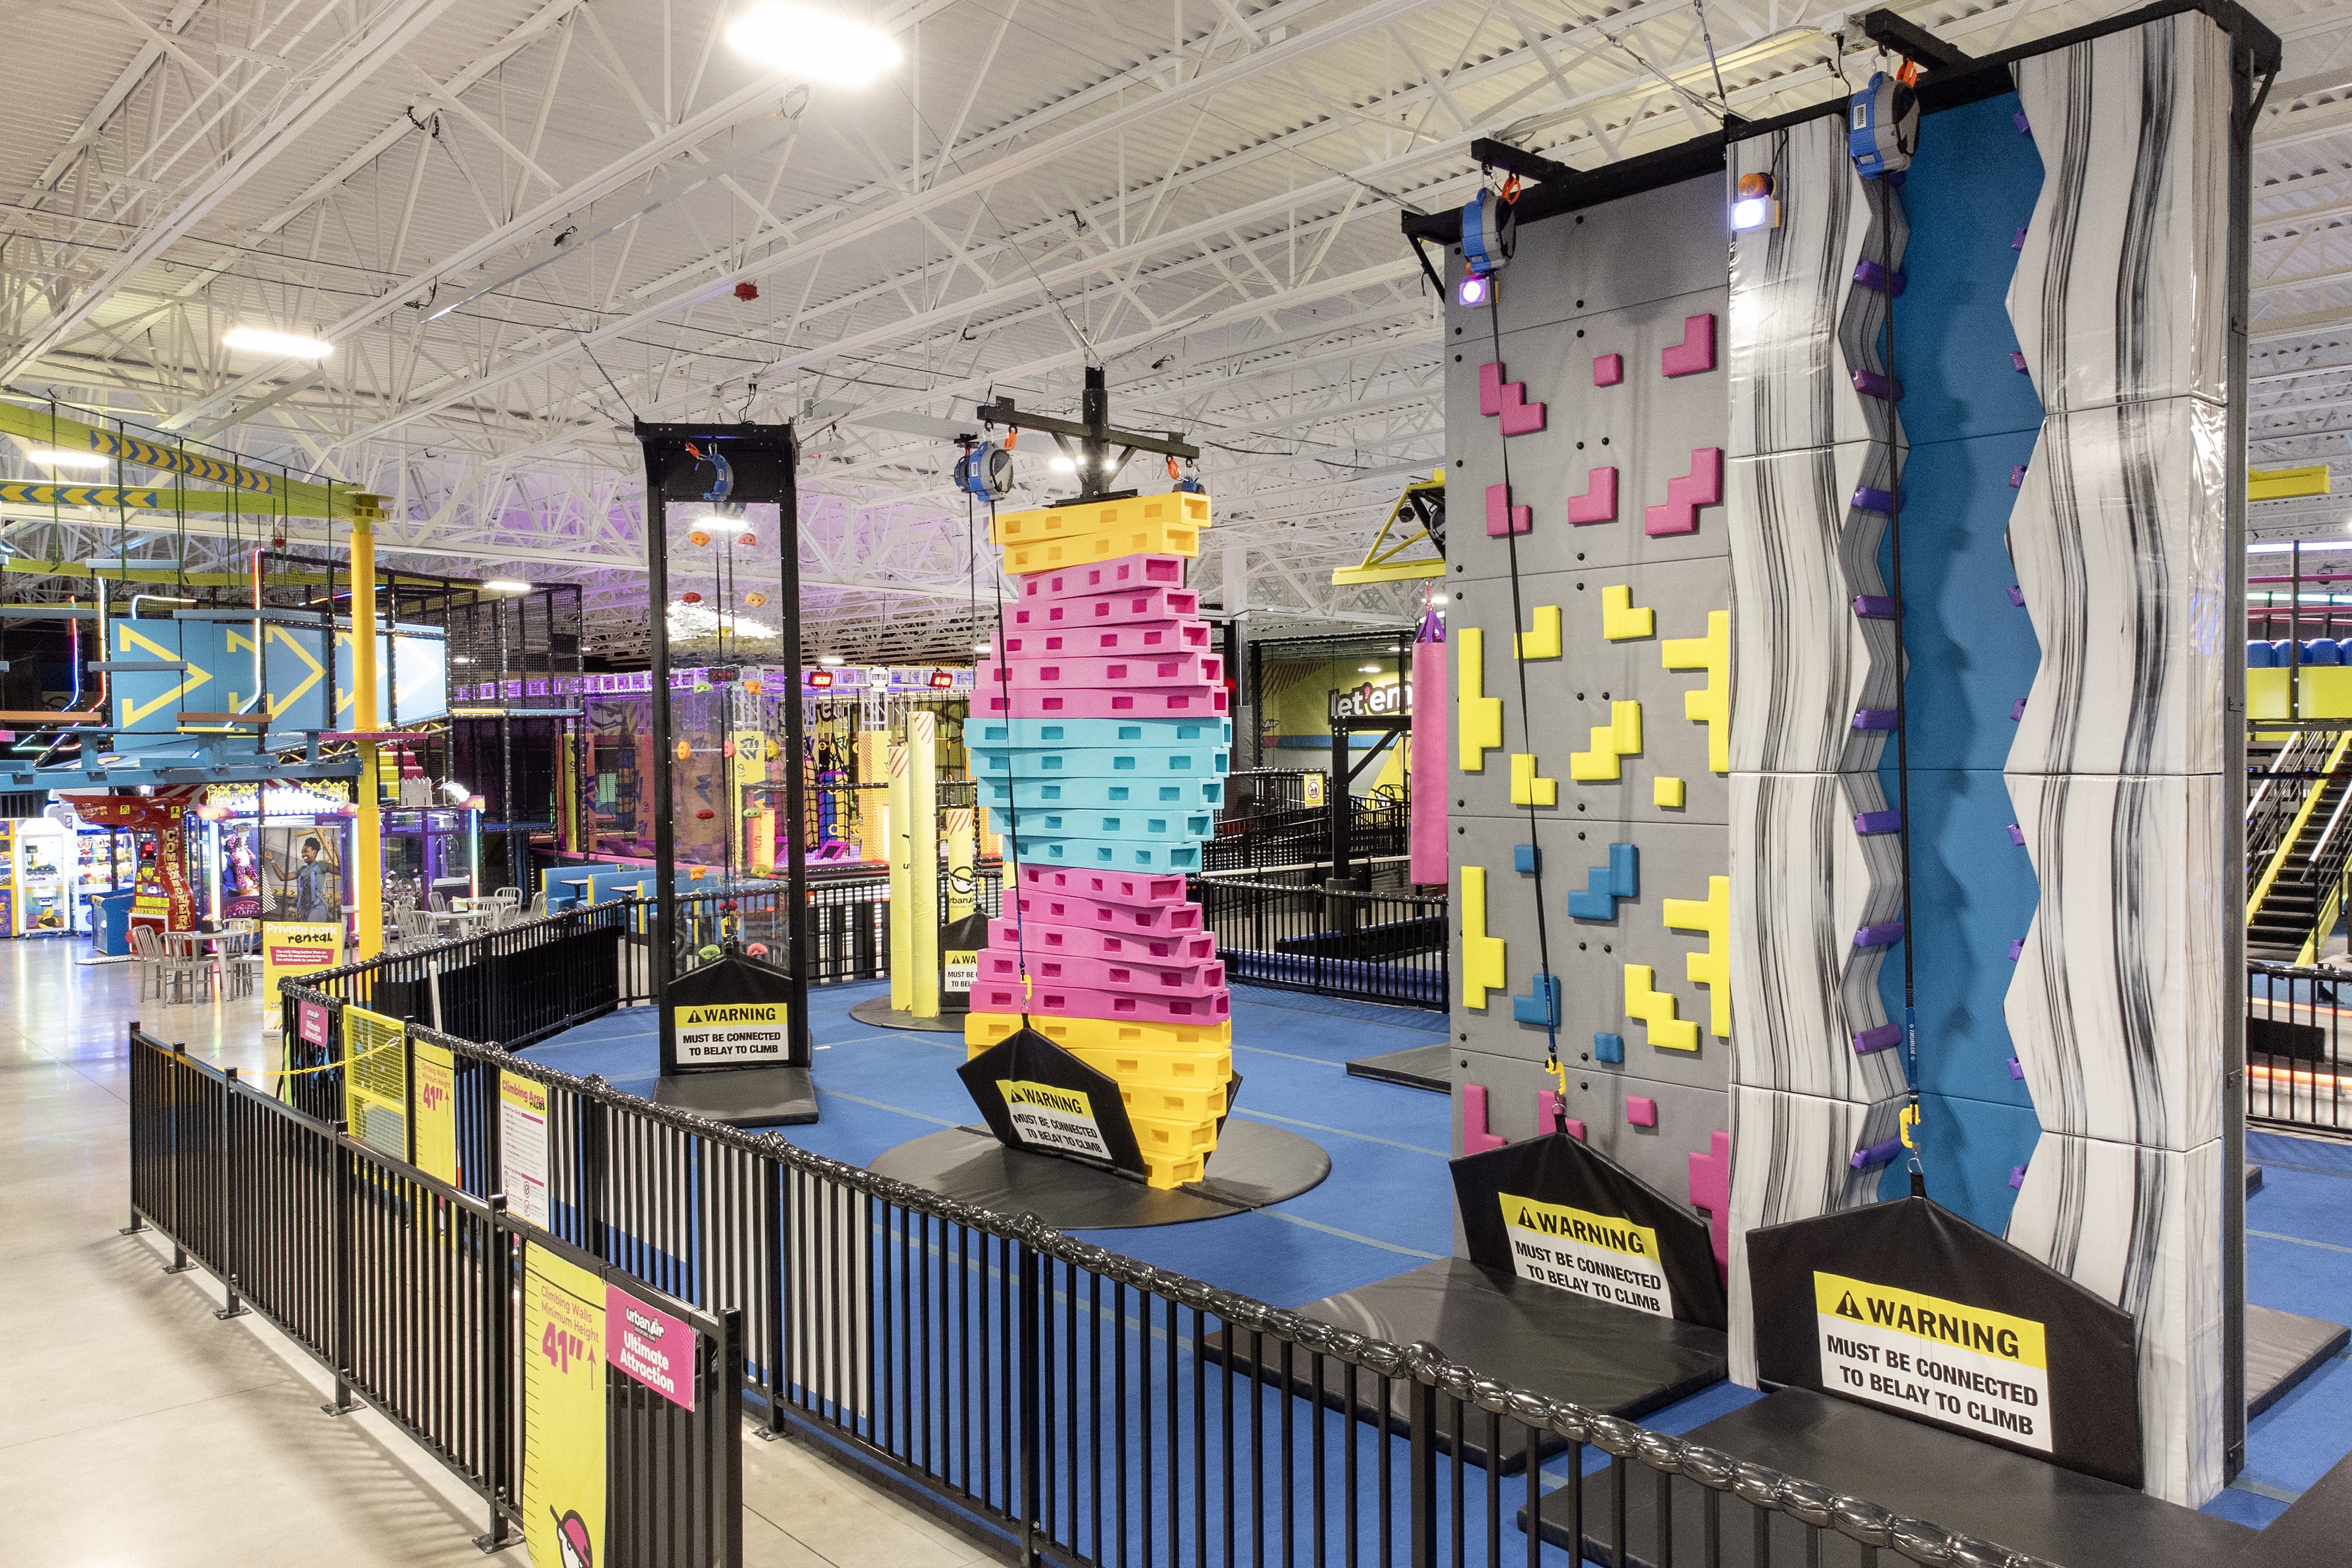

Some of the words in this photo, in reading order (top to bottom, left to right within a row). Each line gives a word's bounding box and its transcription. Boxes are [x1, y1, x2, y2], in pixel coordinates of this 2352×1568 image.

[266, 923, 308, 934] Private
[310, 924, 337, 935] park
[288, 932, 333, 943] rental
[704, 1007, 776, 1022] WARNING
[683, 1034, 709, 1043] MUST
[712, 1034, 724, 1042] BE
[727, 1032, 781, 1042] CONNECTED
[689, 1047, 701, 1056] TO
[704, 1046, 733, 1055] BELAY
[735, 1045, 747, 1054] TO
[750, 1045, 778, 1054] CLIMB
[423, 1083, 443, 1111] 41"
[502, 1079, 528, 1103] Climbing
[529, 1091, 545, 1106] Area
[1022, 1088, 1083, 1114] WARNING
[1013, 1114, 1038, 1125] MUST
[1038, 1116, 1050, 1128] BE
[1050, 1119, 1098, 1138] CONNECTED
[1025, 1128, 1038, 1139] TO
[1040, 1130, 1063, 1144] BELAY
[1063, 1135, 1075, 1146] TO
[1075, 1138, 1102, 1153] CLIMB
[1536, 1212, 1645, 1254] WARNING
[1515, 1240, 1552, 1263] MUST
[1555, 1251, 1574, 1268] BE
[1577, 1257, 1661, 1290] CONNECTED
[541, 1285, 570, 1314] Climbing
[571, 1302, 592, 1323] Walls
[1526, 1264, 1544, 1280] TO
[1547, 1270, 1589, 1293] BELAY
[1592, 1282, 1611, 1299] TO
[1615, 1288, 1661, 1313] CLIMB
[542, 1300, 572, 1328] Minimum
[574, 1320, 599, 1343] Height
[1866, 1297, 2020, 1359] WARNING
[542, 1321, 584, 1375] 41"
[624, 1330, 669, 1371] Ultimate
[620, 1348, 674, 1394] Attraction
[1827, 1334, 1880, 1363] MUST
[1886, 1349, 1911, 1372] BE
[1917, 1358, 2038, 1407] CONNECTED
[1839, 1365, 1864, 1387] TO
[1870, 1372, 1930, 1406] BELAY
[1934, 1391, 1961, 1415] TO
[1967, 1401, 2034, 1436] CLIMB
